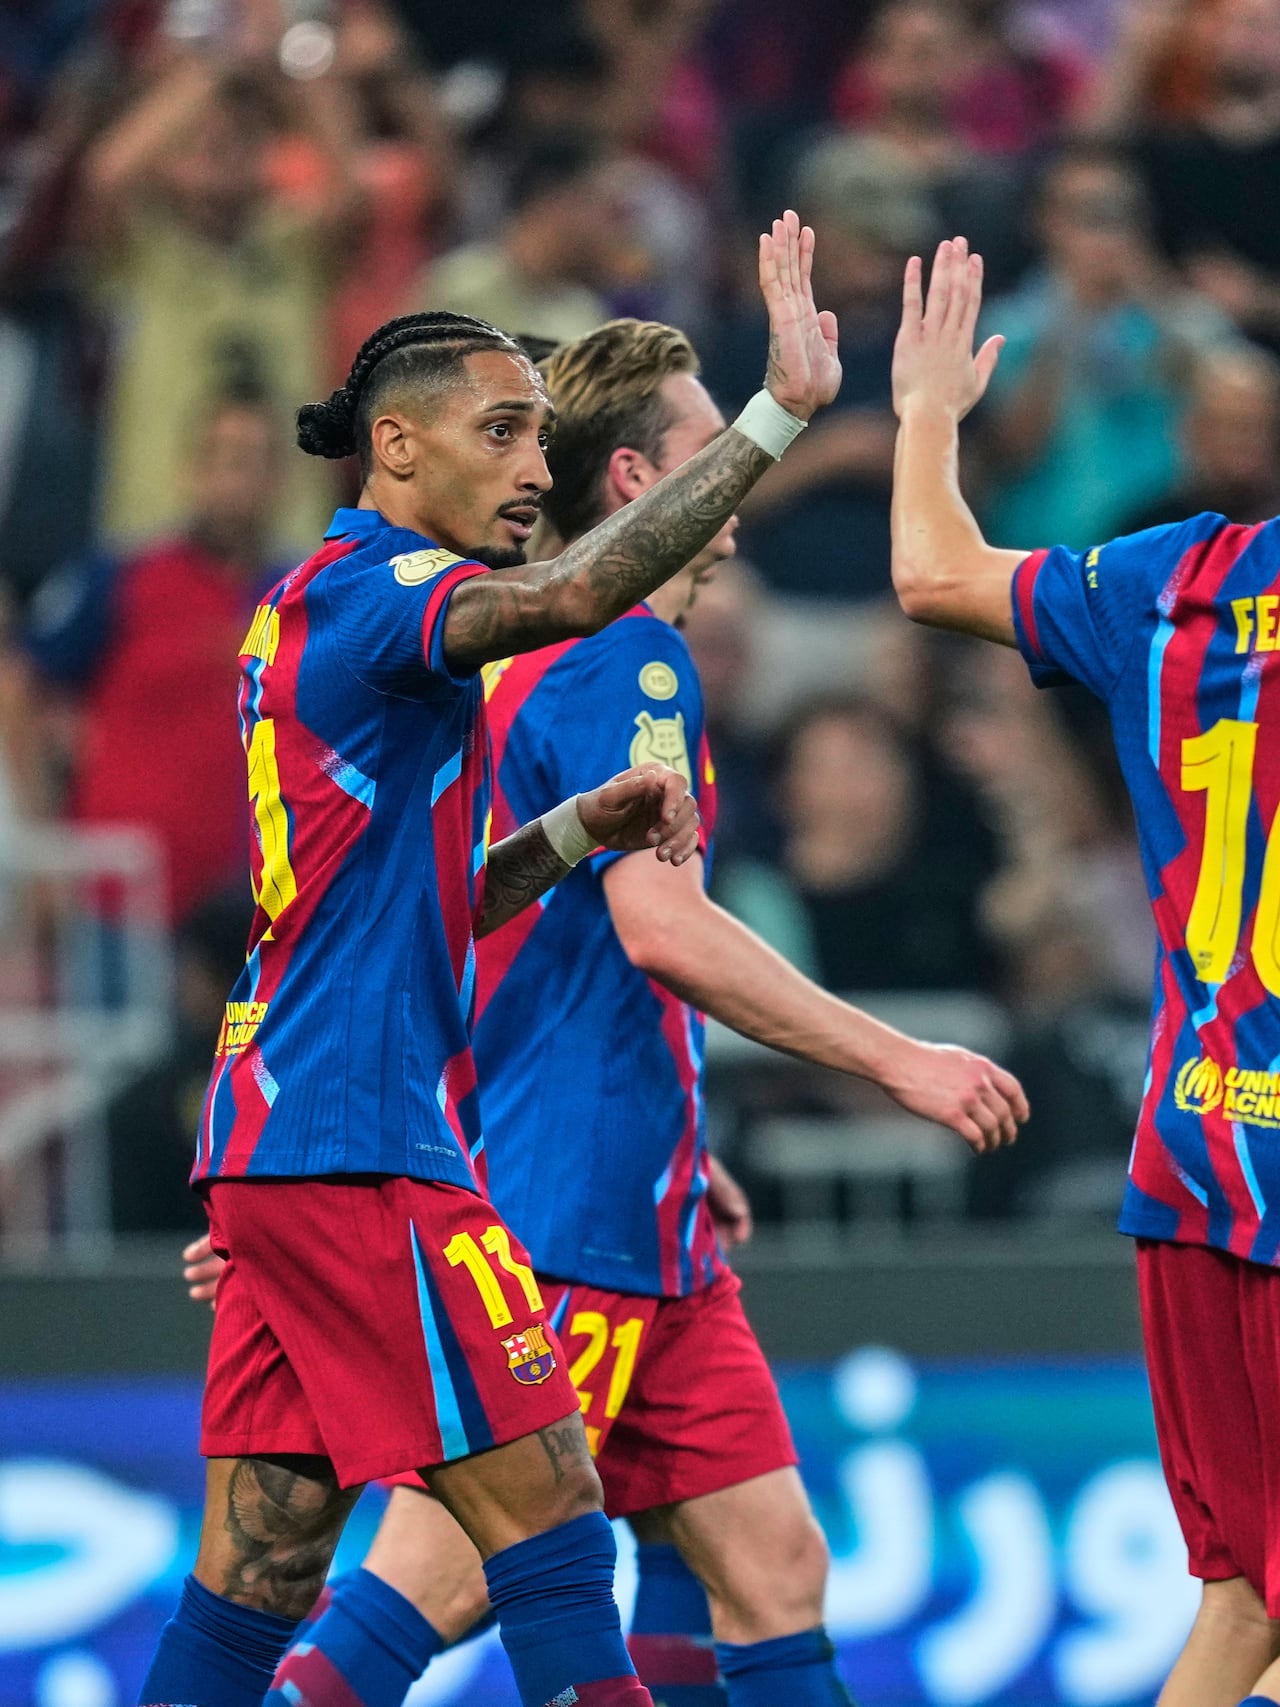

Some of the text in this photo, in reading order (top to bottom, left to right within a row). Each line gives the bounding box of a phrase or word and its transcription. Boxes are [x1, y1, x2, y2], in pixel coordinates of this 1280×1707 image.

[442, 1225, 545, 1330] 11
[521, 1349, 540, 1363] FCB
[570, 1311, 644, 1419] 21
